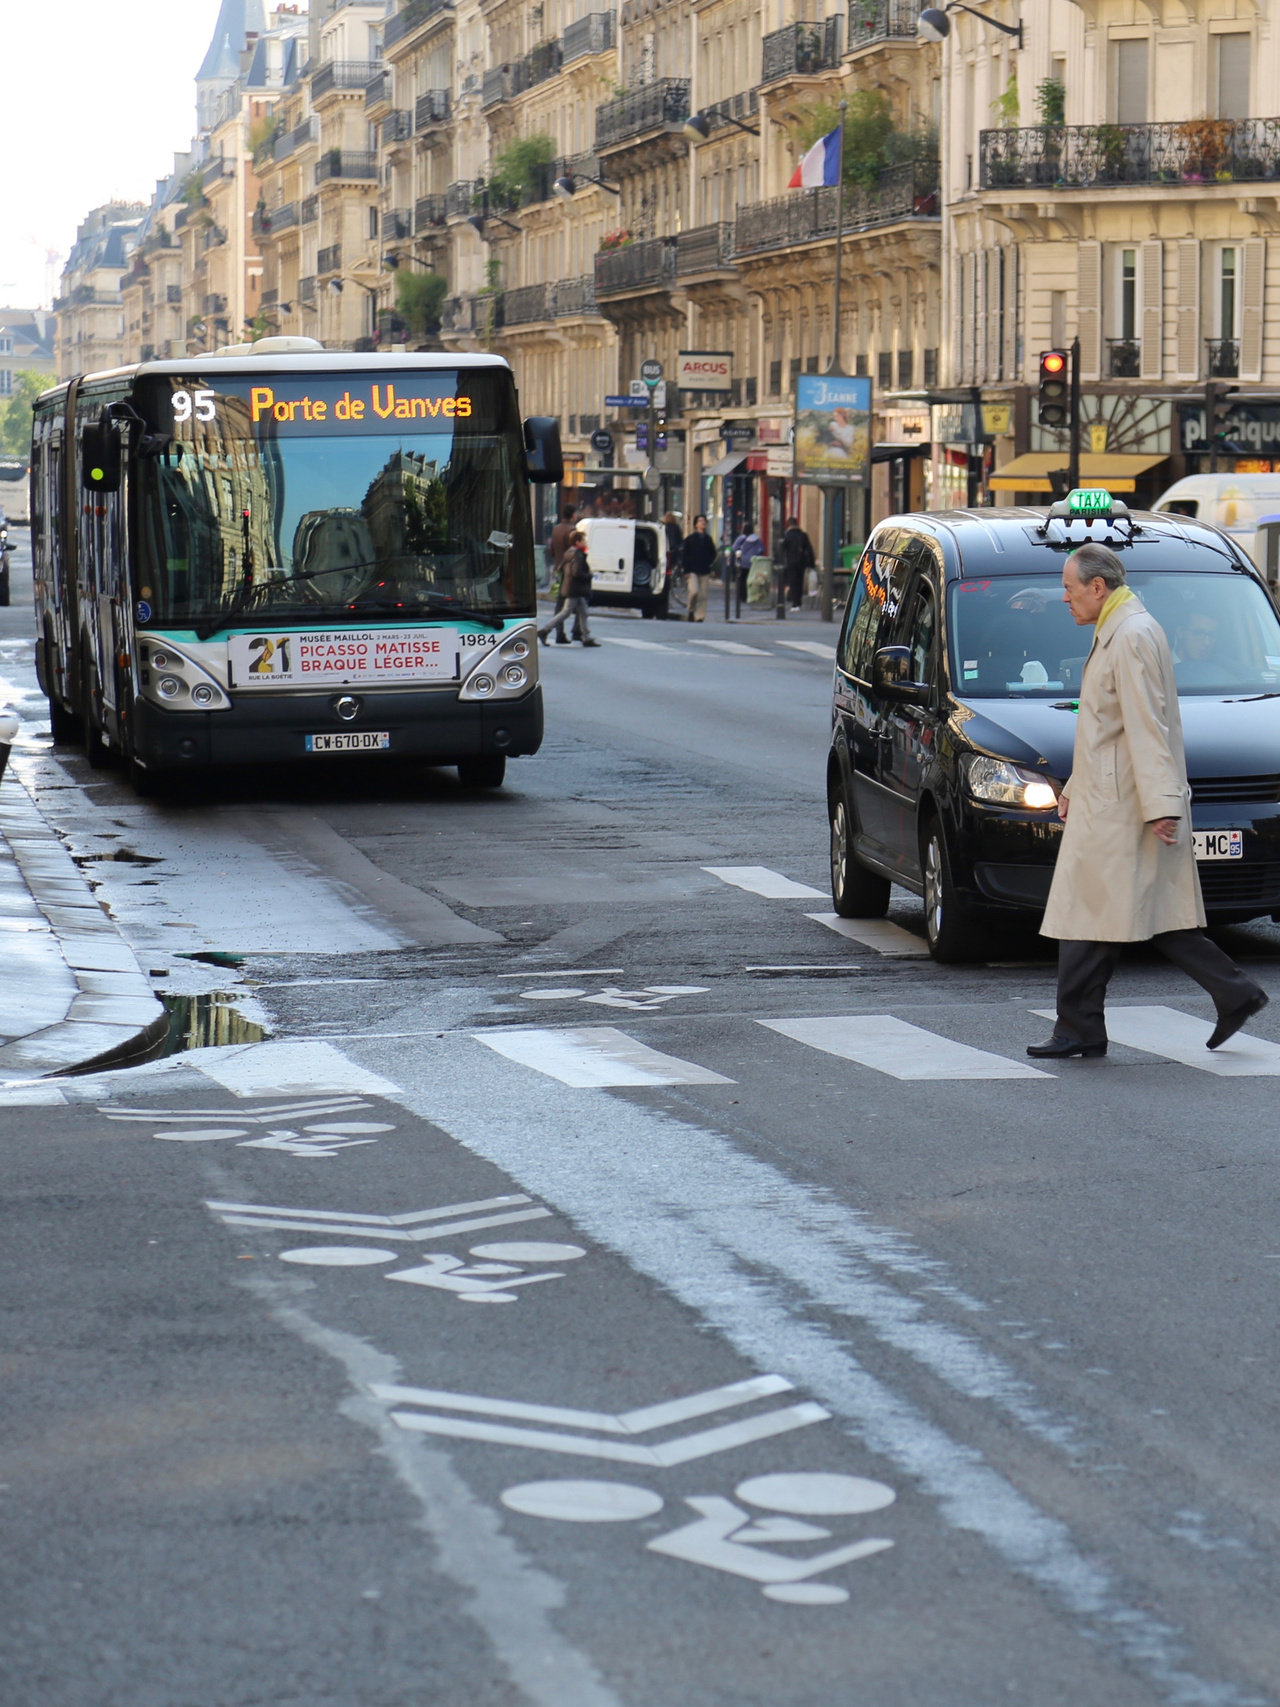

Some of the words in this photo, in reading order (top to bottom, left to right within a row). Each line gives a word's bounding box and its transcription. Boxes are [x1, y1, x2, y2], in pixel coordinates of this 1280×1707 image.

[644, 364, 661, 375] BUS
[683, 361, 728, 376] ARCUS
[171, 390, 216, 422] 95
[251, 387, 327, 422] Porte
[334, 392, 365, 420] de
[371, 384, 472, 419] Vanves
[1076, 493, 1106, 508] TAXI
[1069, 508, 1112, 516] PARISIEN
[300, 634, 332, 643] MUSÉE
[334, 633, 374, 642] MAILLOL
[459, 634, 497, 647] 1984
[248, 637, 292, 673] 21
[300, 643, 368, 657] PICASSO
[375, 641, 441, 655] MATISSE
[301, 658, 367, 672] BRAQUE
[374, 654, 438, 669] LÉGER...
[315, 734, 379, 749] CW-670-DX
[1230, 844, 1240, 854] 95
